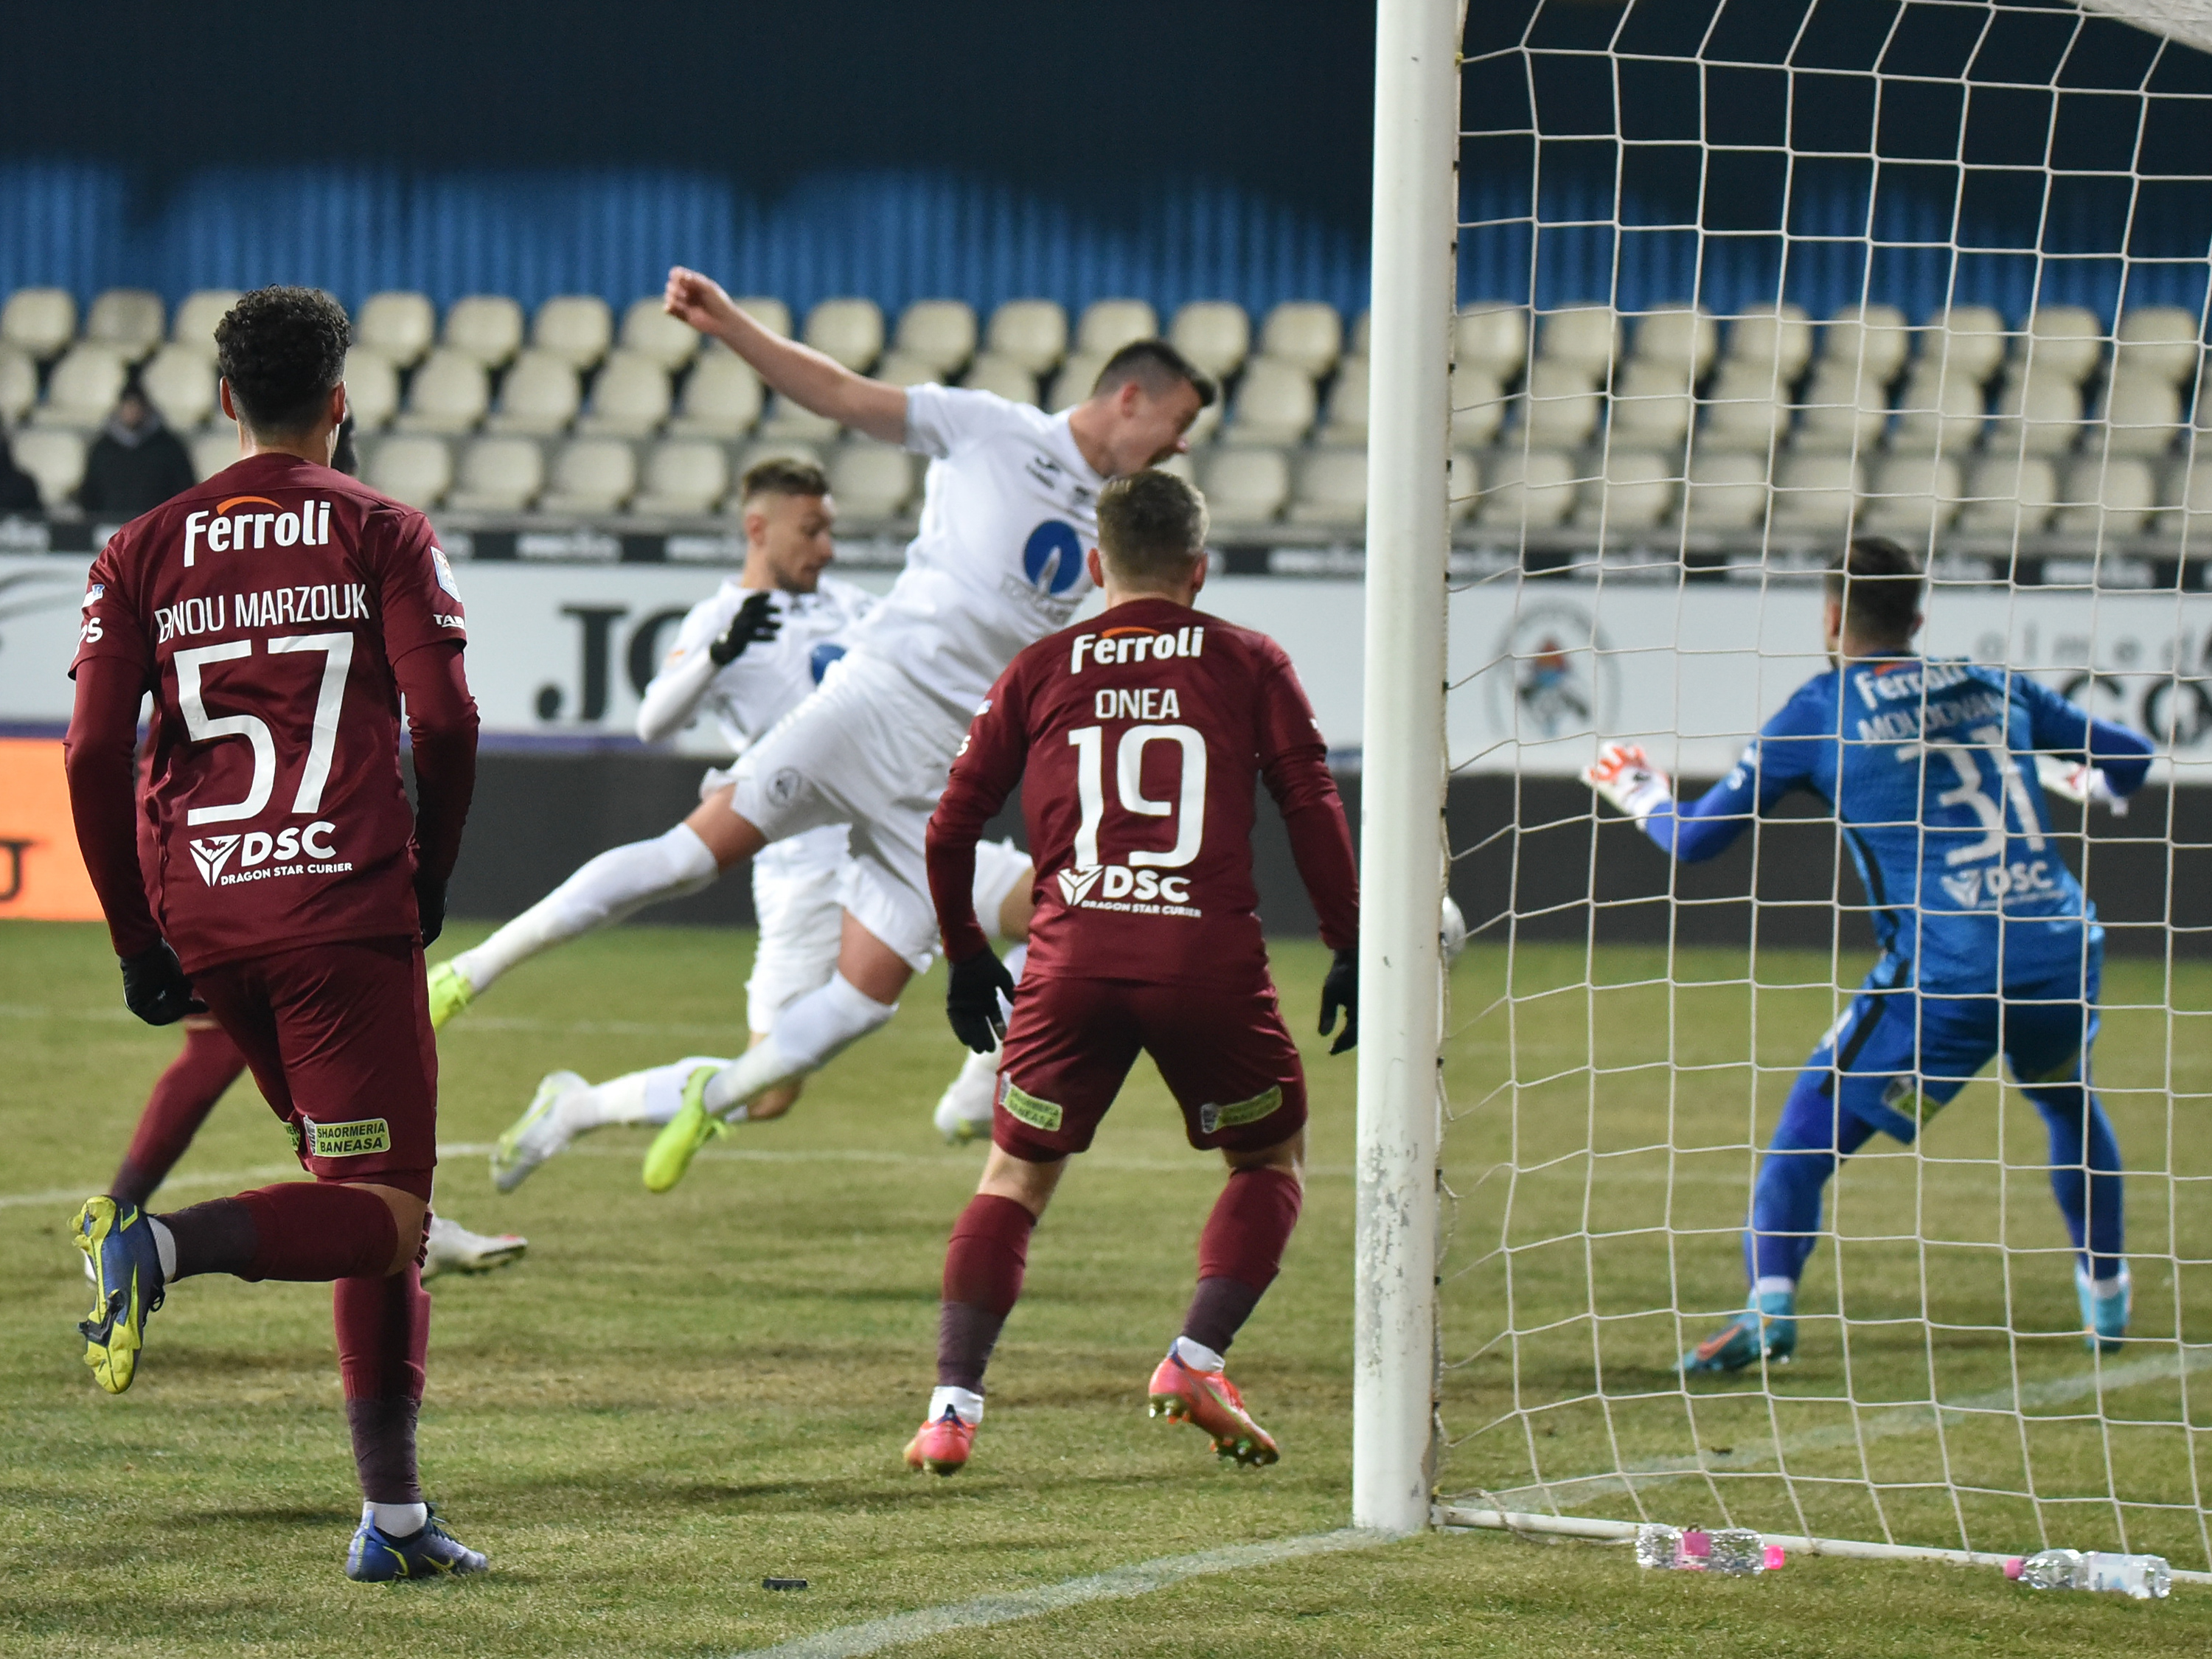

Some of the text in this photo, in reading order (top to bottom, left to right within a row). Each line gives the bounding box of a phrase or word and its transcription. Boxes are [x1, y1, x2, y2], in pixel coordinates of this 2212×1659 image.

[184, 500, 331, 567] Ferroli
[154, 583, 369, 644] BNOU MARZOUK
[1071, 627, 1205, 674] Ferroli
[1096, 689, 1180, 720] ONEA
[173, 632, 354, 826] 57
[1068, 724, 1207, 869] 19
[1894, 725, 2045, 866] 31
[241, 821, 336, 867] DSC
[221, 863, 352, 886] DRAGON STAR CURIER
[1102, 866, 1192, 903] DSC
[1985, 860, 2053, 895] DSC
[1081, 900, 1130, 912] DRAGON
[1132, 903, 1160, 914] STAR
[317, 1123, 385, 1138] SHAORMERIA
[320, 1137, 383, 1153] BANEASA
